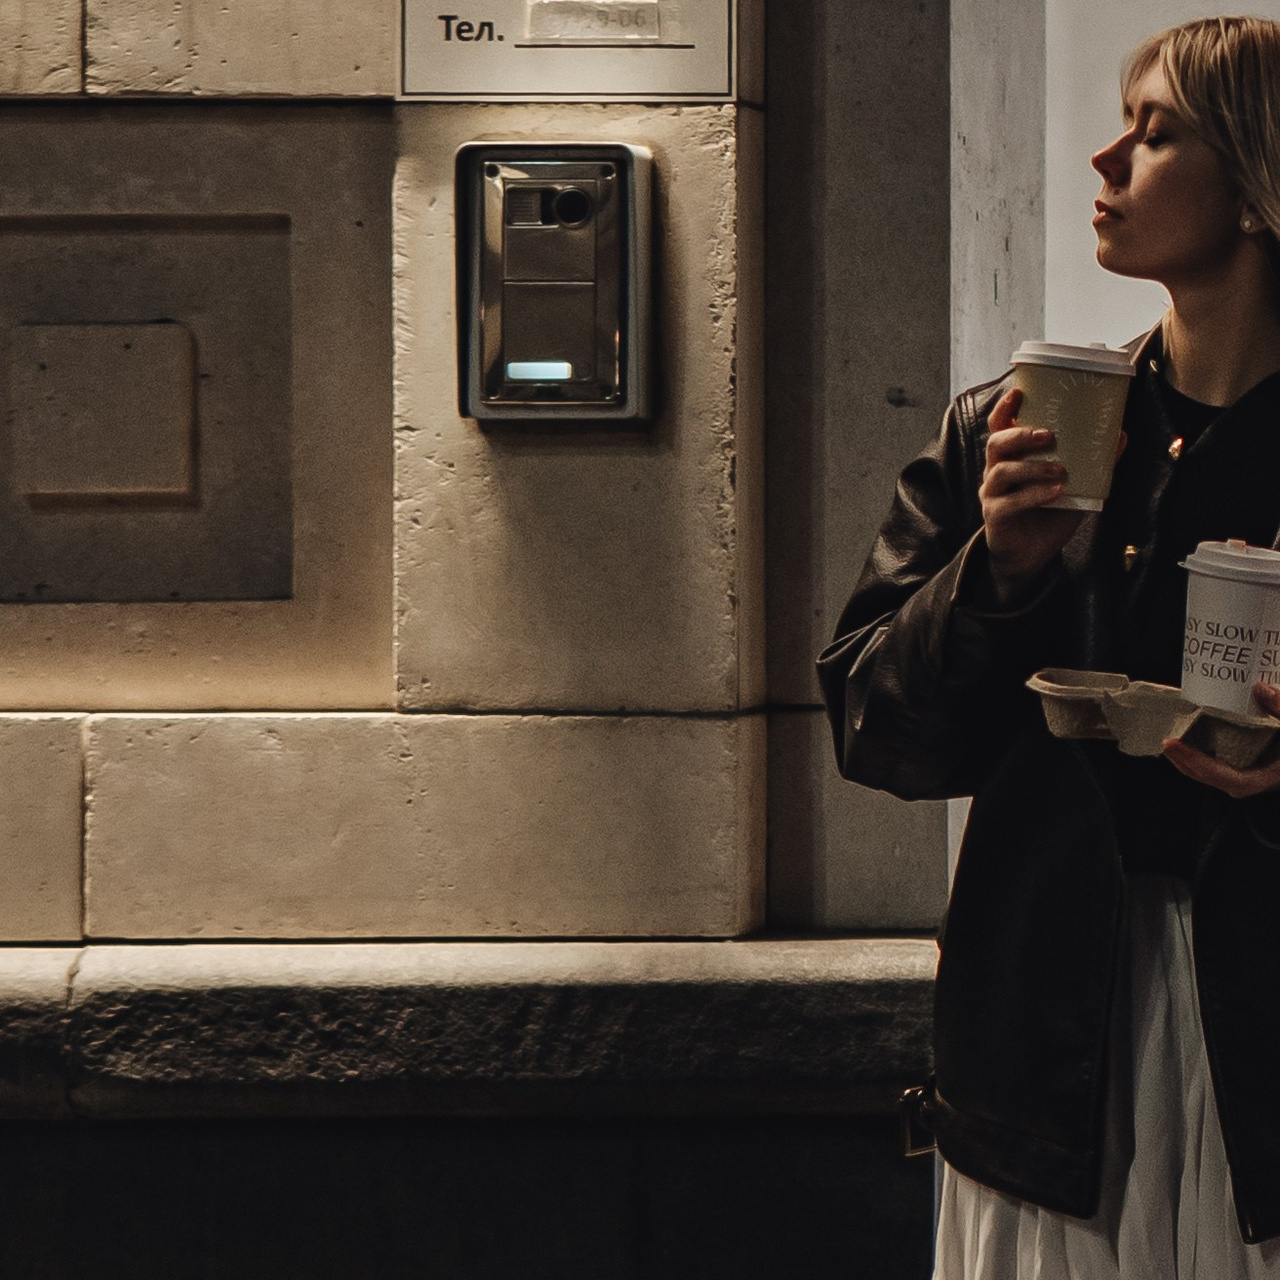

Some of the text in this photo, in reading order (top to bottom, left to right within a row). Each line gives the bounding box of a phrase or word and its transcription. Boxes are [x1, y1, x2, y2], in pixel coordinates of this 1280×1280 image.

[438, 14, 504, 42] Тел.
[1205, 621, 1259, 643] SLOW
[1201, 662, 1249, 683] SLOW
